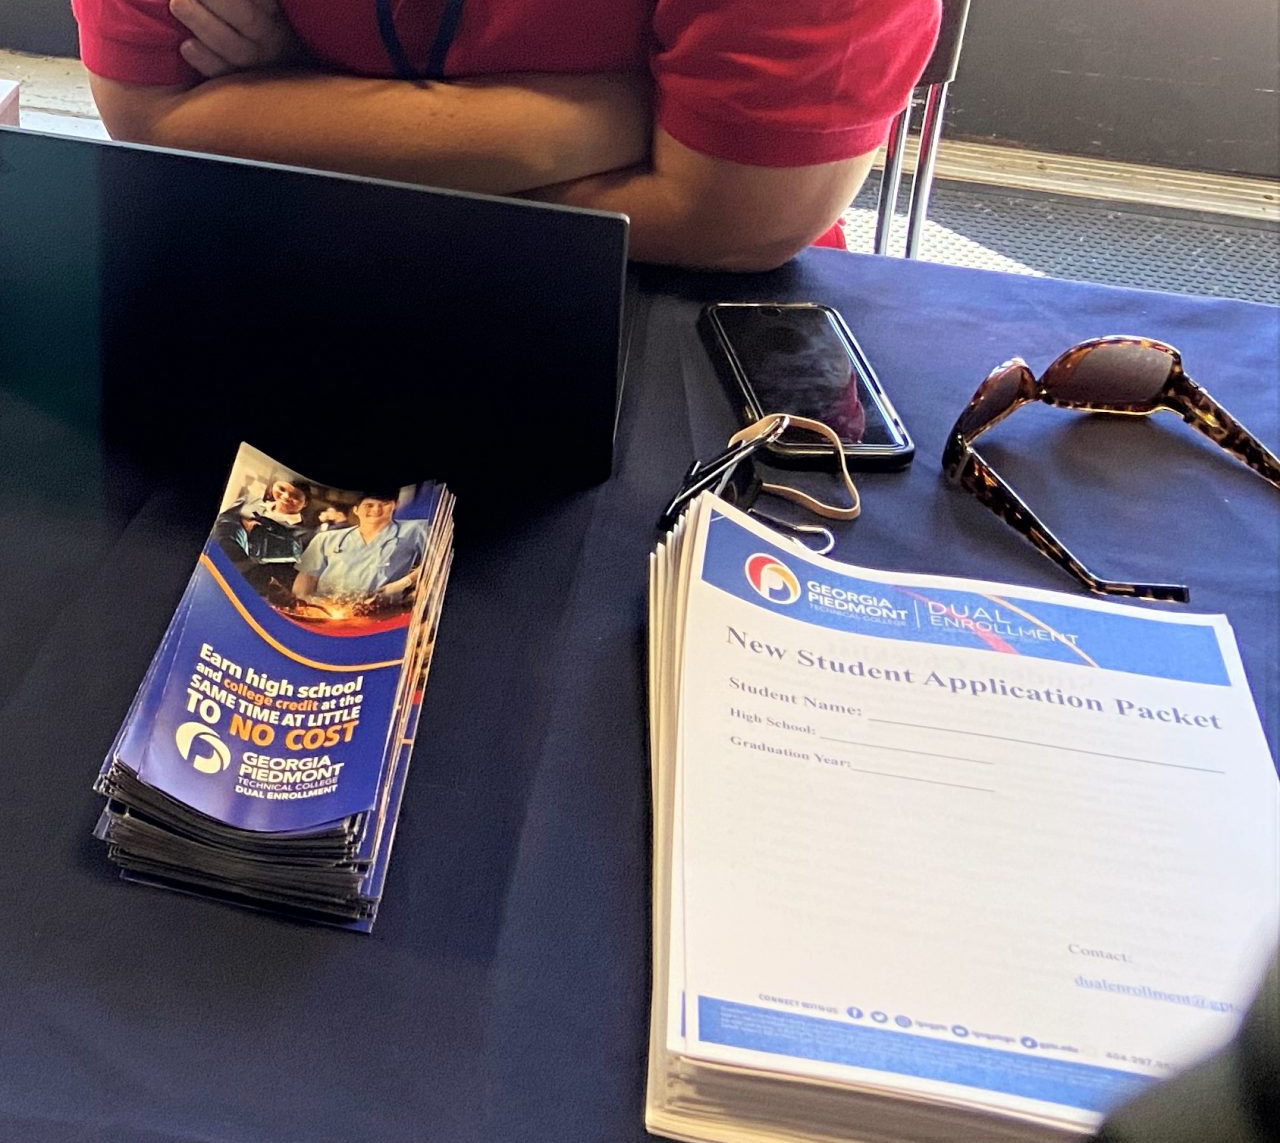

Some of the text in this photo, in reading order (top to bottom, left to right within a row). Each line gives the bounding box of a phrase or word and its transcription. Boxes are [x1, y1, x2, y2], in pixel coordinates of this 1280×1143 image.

[807, 580, 892, 608] GEORGIA
[808, 591, 908, 620] PIEDMONT
[809, 602, 862, 621] TECHNICAL
[928, 601, 1012, 624] DUAL
[929, 614, 1079, 645] ENROLLMENT
[200, 643, 363, 698] Earn high school
[726, 624, 1223, 731] New Student Application Packet
[190, 674, 361, 727] SAME TIME AT LITTLE
[196, 663, 363, 711] and college credit at the
[728, 676, 864, 717] Student Name:
[186, 688, 359, 750] TO NO COST
[730, 707, 817, 736] High School:
[242, 752, 331, 770] GEORGIA
[730, 735, 852, 769] Graduation Year:
[238, 776, 338, 791] TECHNICAL COLLEGE
[239, 762, 345, 783] PIEDMONT
[235, 784, 338, 800] DUAL ENROLLMENT
[758, 993, 799, 1006] CONNECT
